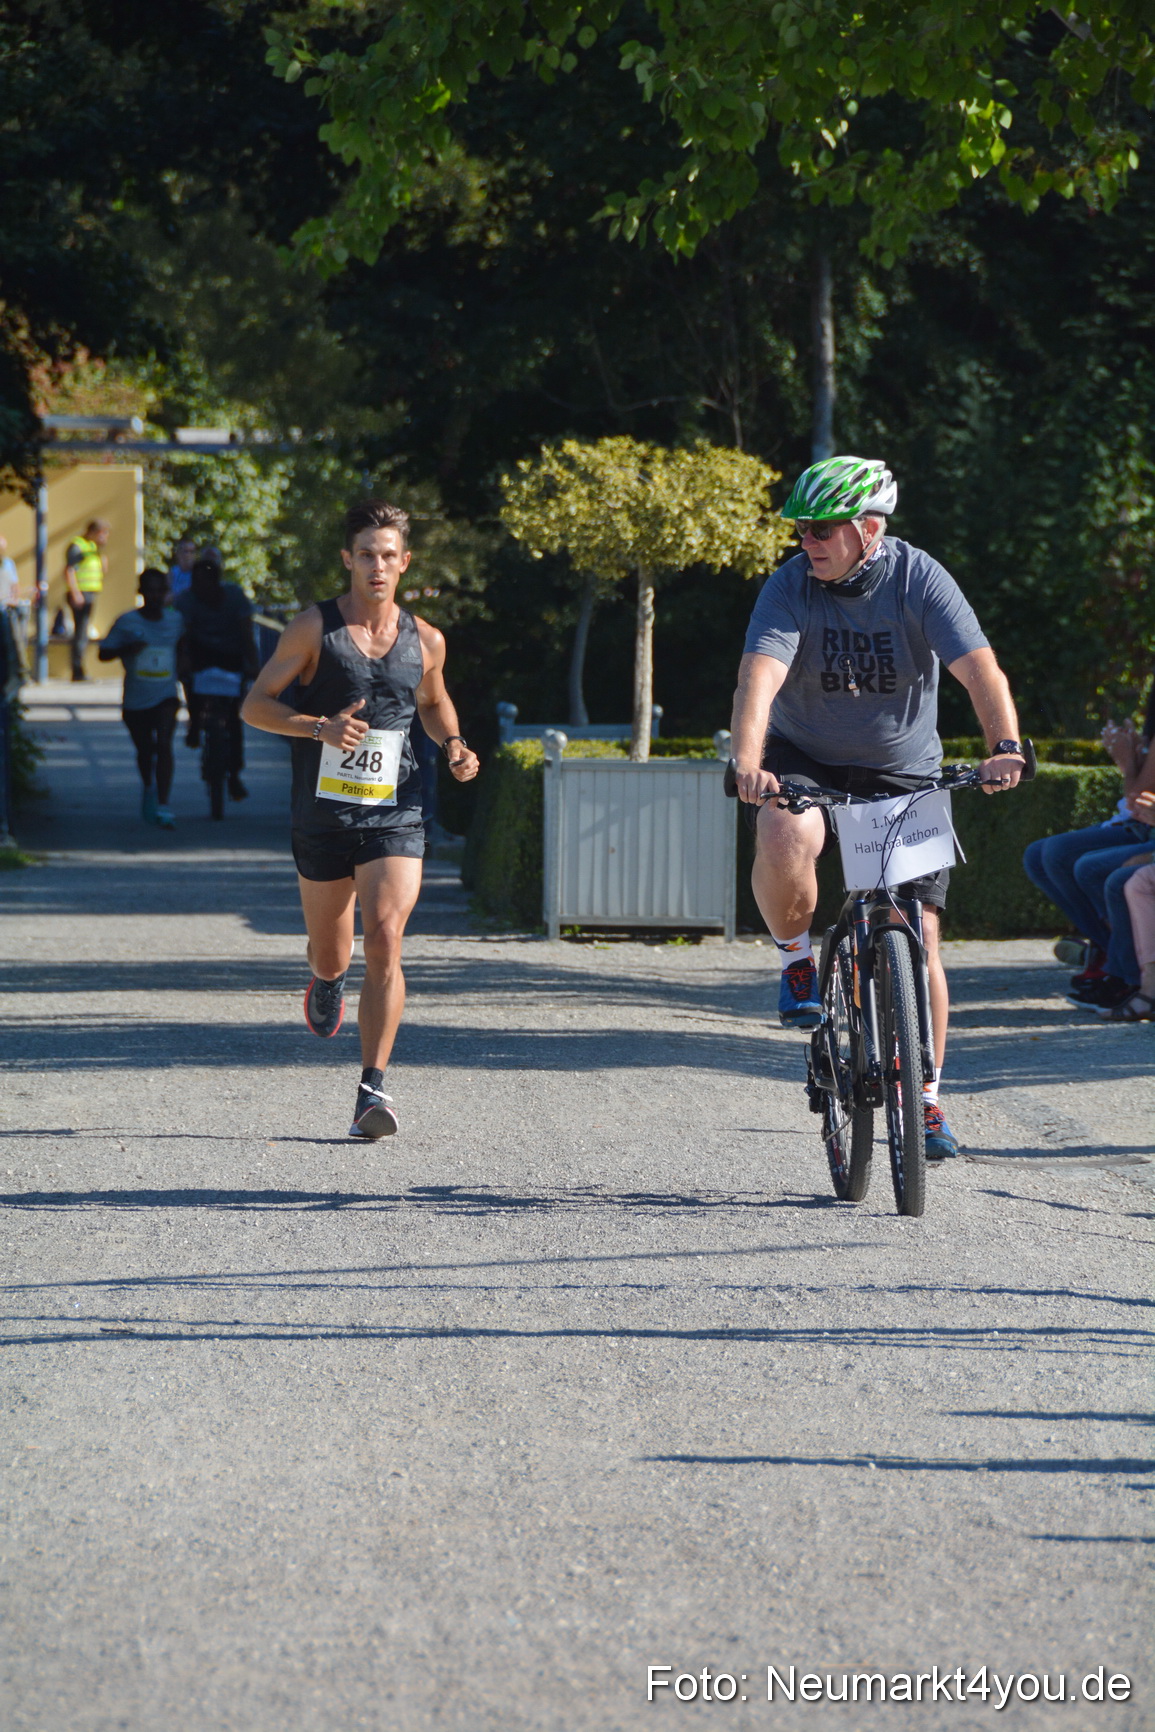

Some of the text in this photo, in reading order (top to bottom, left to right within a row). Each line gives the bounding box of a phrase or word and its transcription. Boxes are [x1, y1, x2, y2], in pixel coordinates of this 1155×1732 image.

[822, 627, 894, 654] RIDE
[822, 652, 897, 674] YOUR
[820, 672, 897, 694] BIKE
[340, 750, 383, 773] 248
[342, 783, 375, 796] Patrick
[854, 826, 939, 854] Halbmarathon
